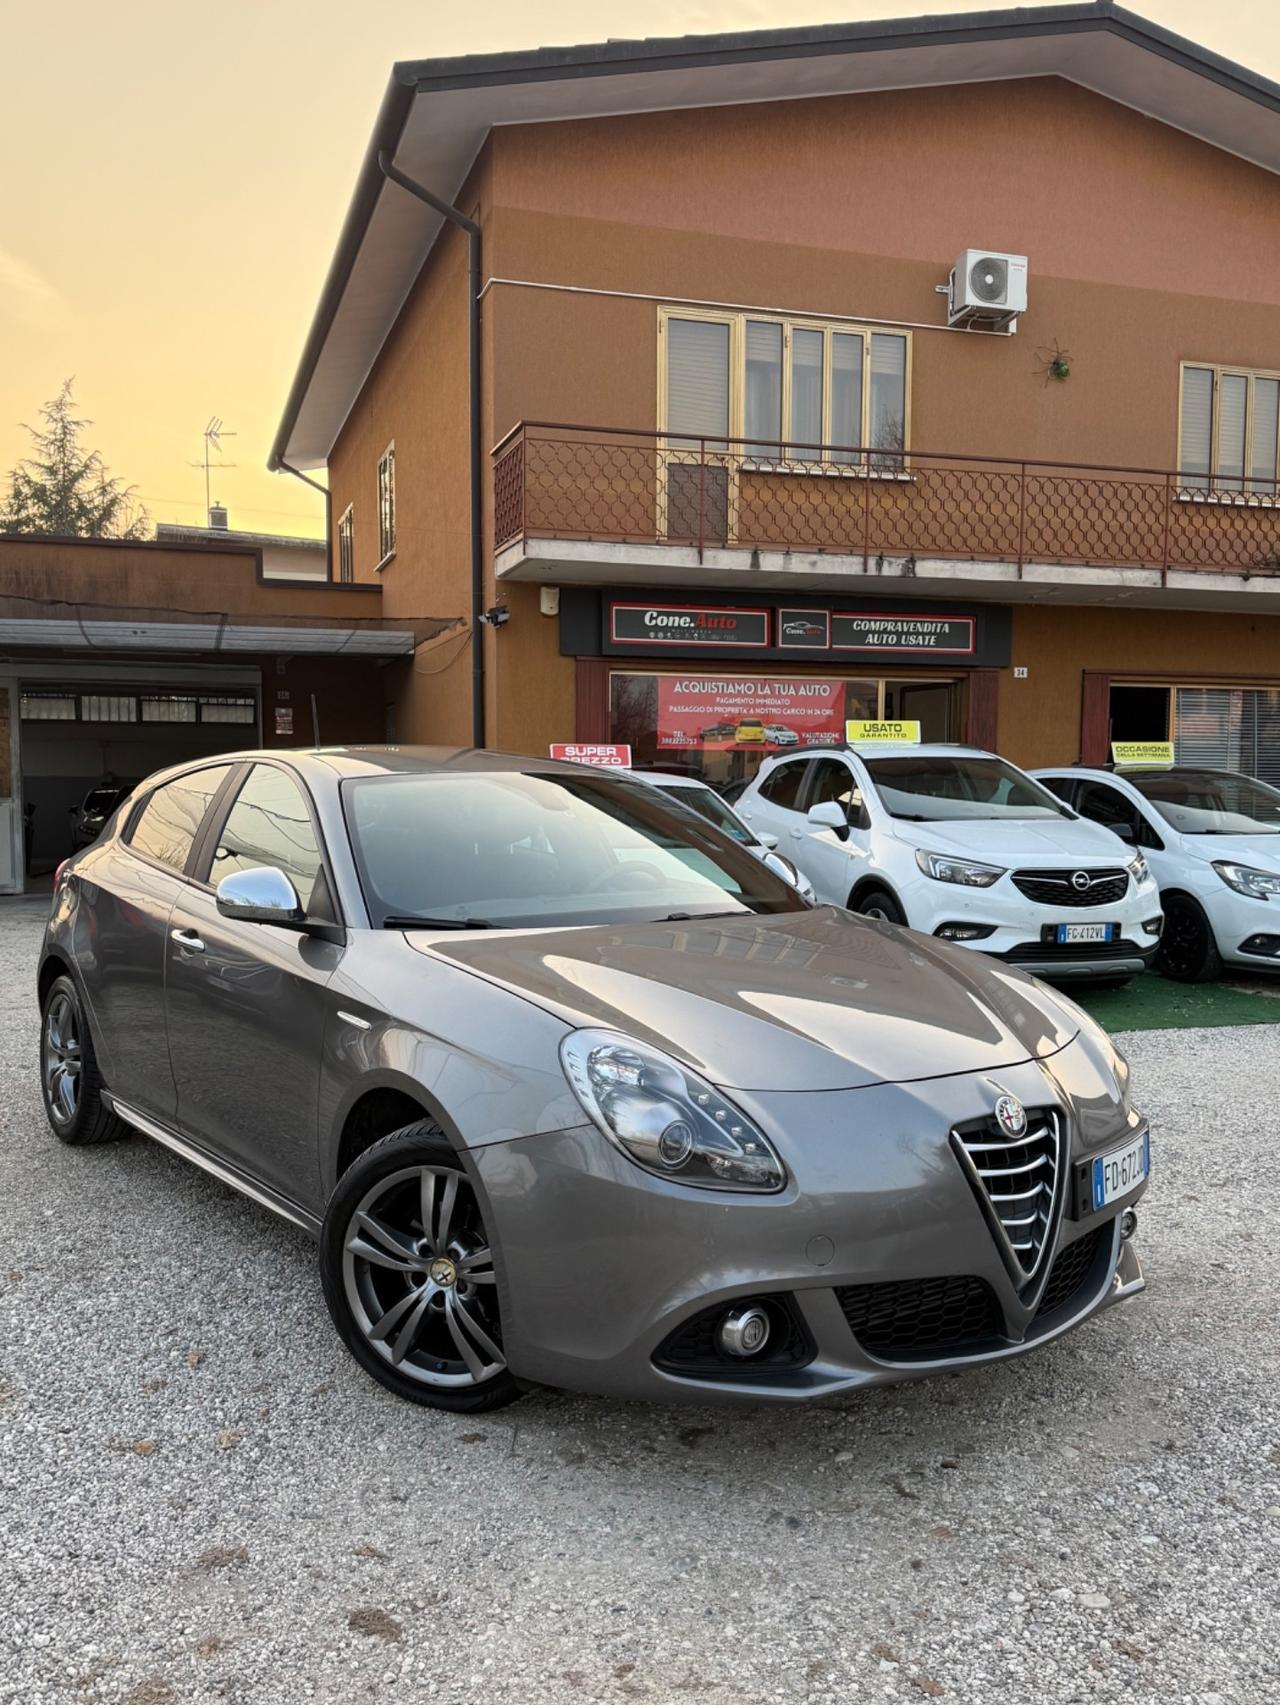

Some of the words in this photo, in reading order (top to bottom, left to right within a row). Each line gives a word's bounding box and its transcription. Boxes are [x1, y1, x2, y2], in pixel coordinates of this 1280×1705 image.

[644, 611, 737, 629] Cone.Auto
[853, 620, 950, 633] COMPRAVENDITA
[865, 633, 897, 645] AUTO
[901, 634, 937, 646] USATE
[673, 681, 755, 695] ACQUISTIAMO
[757, 683, 771, 695] LA
[774, 684, 796, 696] TUA
[798, 684, 831, 697] AUTO
[716, 696, 754, 705] PAGAMENTO
[755, 698, 791, 706] IMMEDIATO
[668, 704, 705, 713] PASSAGGIO
[863, 723, 902, 732] USATO
[565, 746, 617, 756] SUPER
[1115, 745, 1170, 753] OCCASIONE
